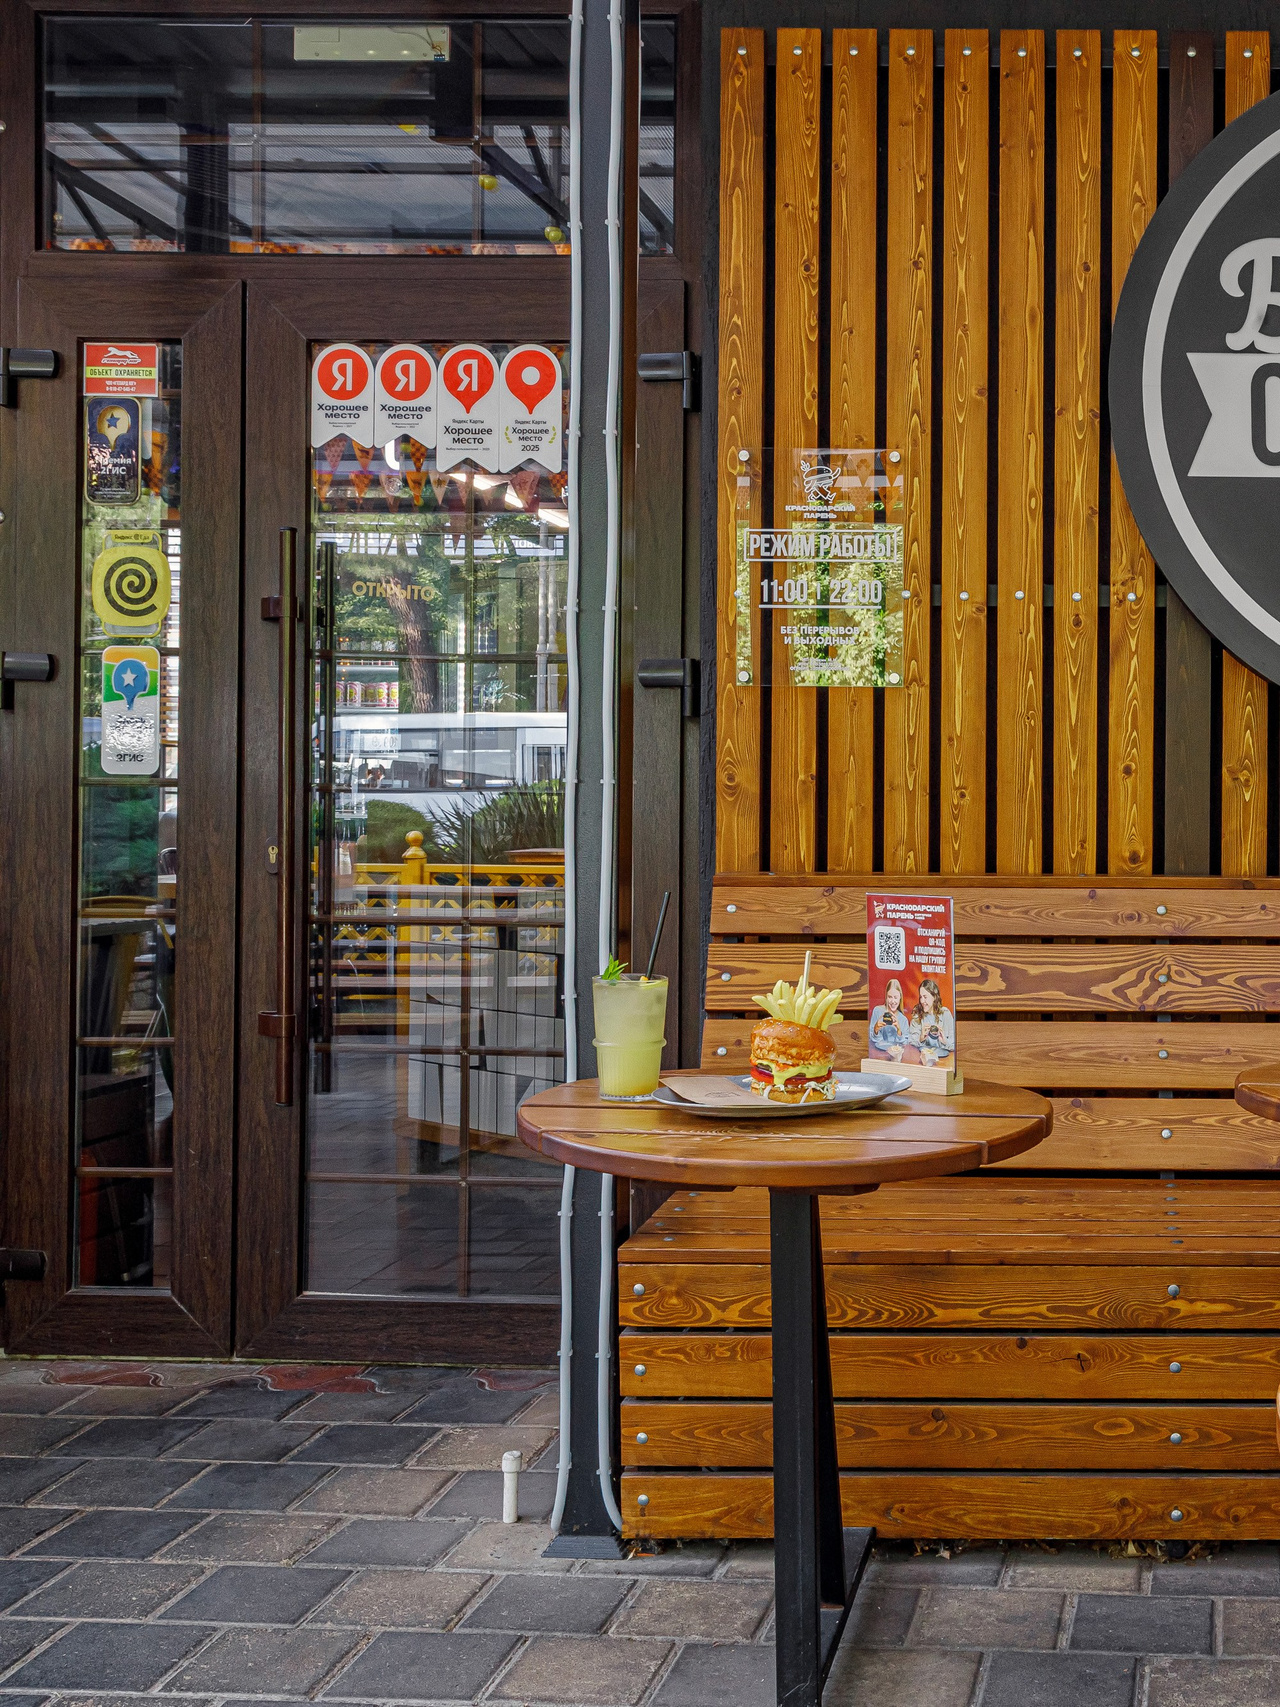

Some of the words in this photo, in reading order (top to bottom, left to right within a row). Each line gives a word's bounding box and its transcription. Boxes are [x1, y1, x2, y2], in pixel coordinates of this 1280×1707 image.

[89, 368, 113, 376] ОБЪЕКТ
[114, 369, 153, 377] ОХРАНЯЕТСЯ
[331, 358, 353, 391] Я
[394, 359, 416, 392] Я
[457, 359, 479, 392] Я
[317, 403, 369, 414] Хорошее
[380, 404, 432, 414] Хорошее
[324, 411, 361, 419] место
[387, 412, 423, 420] место
[443, 425, 493, 437] Хорошее
[511, 427, 550, 436] Хорошее
[452, 437, 484, 445] место
[521, 444, 540, 452] 2025
[785, 504, 856, 512] КРАСНОДАРСКИЙ
[749, 534, 815, 557] РЕЖИМ
[819, 535, 891, 558] РАБОТЫ
[352, 580, 435, 602] ОТКРЫТО
[760, 579, 808, 603] 11:00
[829, 579, 883, 604] 22:00
[780, 626, 799, 635] БЕЗ
[800, 626, 861, 636] ПЕРЕРЫВОВ
[783, 636, 792, 645] И
[793, 636, 856, 647] ВЫХОДНЫХ
[887, 904, 945, 912] КРАСНОДАРСКИЙ
[917, 928, 945, 937] ОТСКАНИРУЙ
[908, 955, 915, 963] НА
[916, 955, 928, 963] НАШУ
[929, 956, 946, 964] ГРУППУ
[922, 965, 946, 973] ВКОНТАКТЕ
